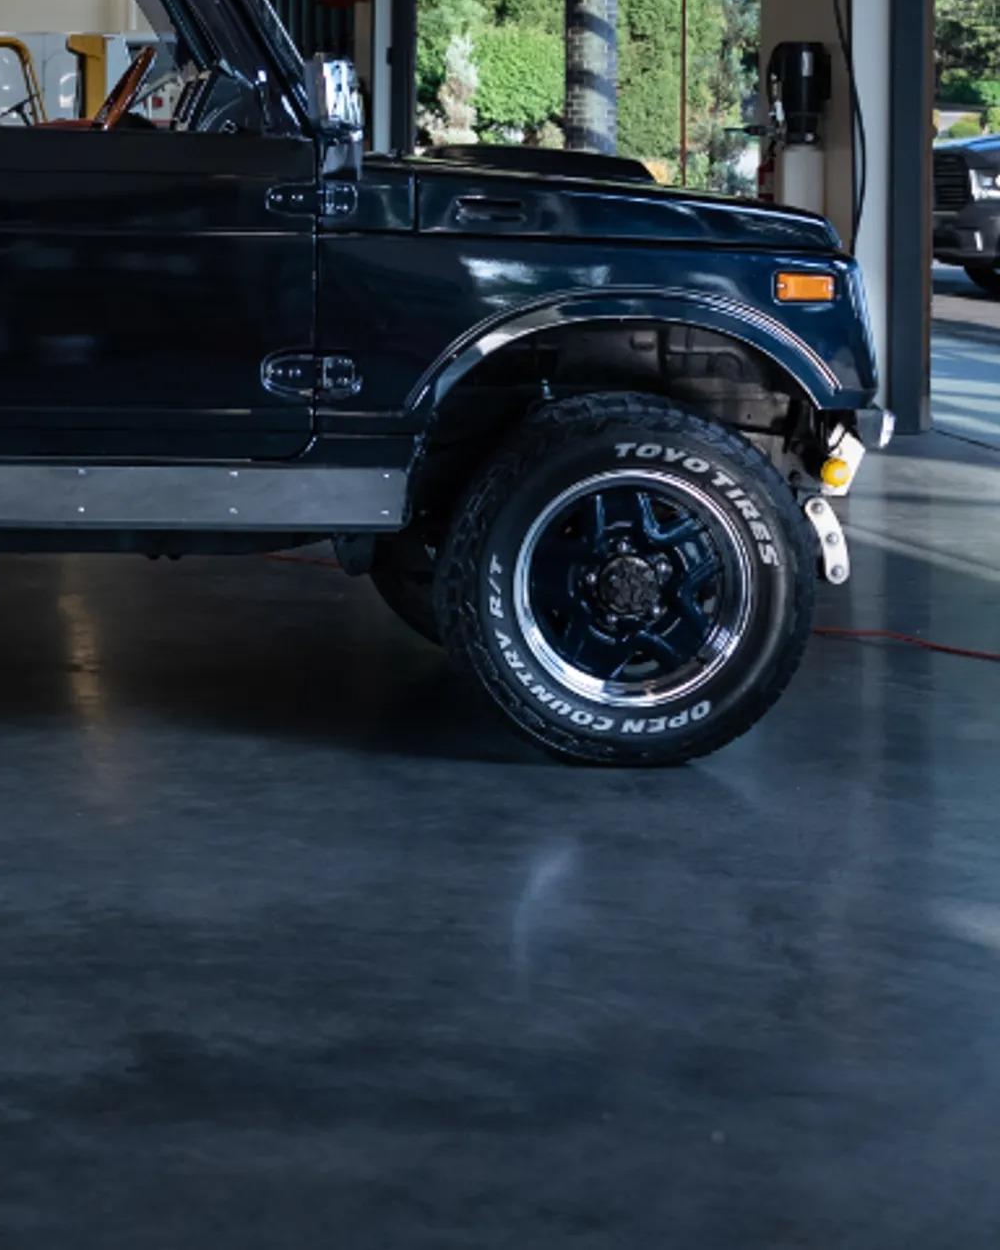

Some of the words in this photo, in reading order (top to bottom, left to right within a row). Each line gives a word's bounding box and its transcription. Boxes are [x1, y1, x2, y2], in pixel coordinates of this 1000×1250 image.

[614, 442, 709, 472] TOYO
[709, 462, 780, 567] TIRES
[488, 554, 503, 619] R/T
[494, 630, 613, 732] COUNTRY
[621, 700, 711, 733] OPEN
